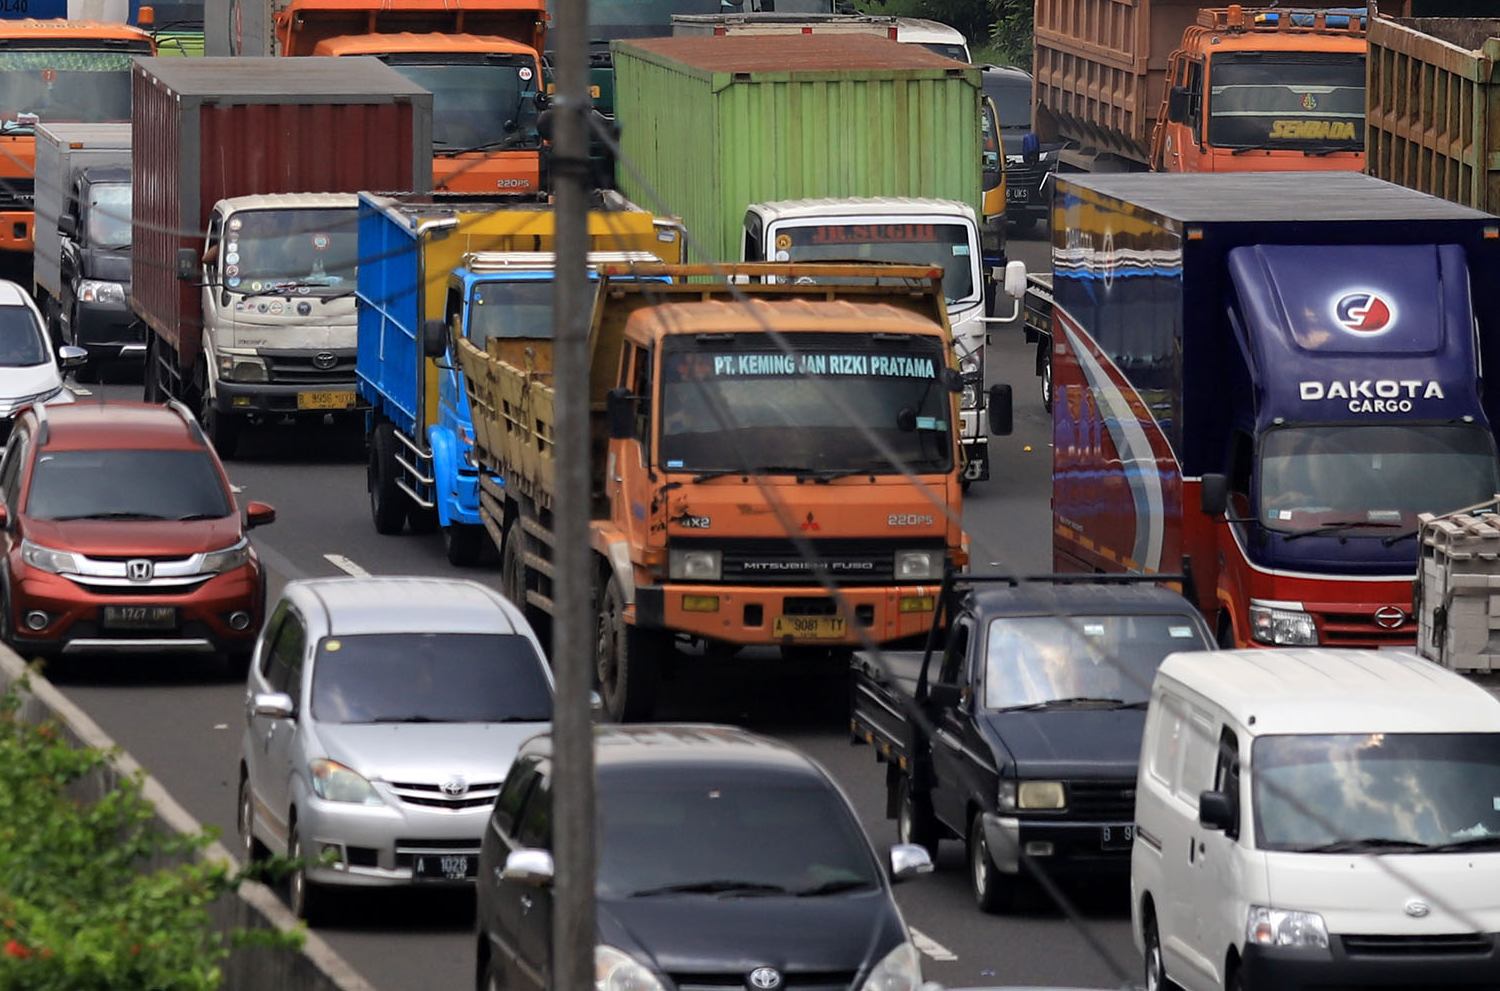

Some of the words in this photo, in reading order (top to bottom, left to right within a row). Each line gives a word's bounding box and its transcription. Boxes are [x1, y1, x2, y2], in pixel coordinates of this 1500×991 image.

[714, 356, 735, 375] PT.
[739, 356, 795, 375] KEMING
[829, 356, 867, 375] RIZKI
[871, 357, 935, 378] PRATAMA
[1300, 380, 1445, 400] DAKOTA
[1348, 400, 1412, 412] CARGO
[888, 514, 933, 526] 220PS
[776, 621, 783, 631] A
[417, 858, 424, 873] A
